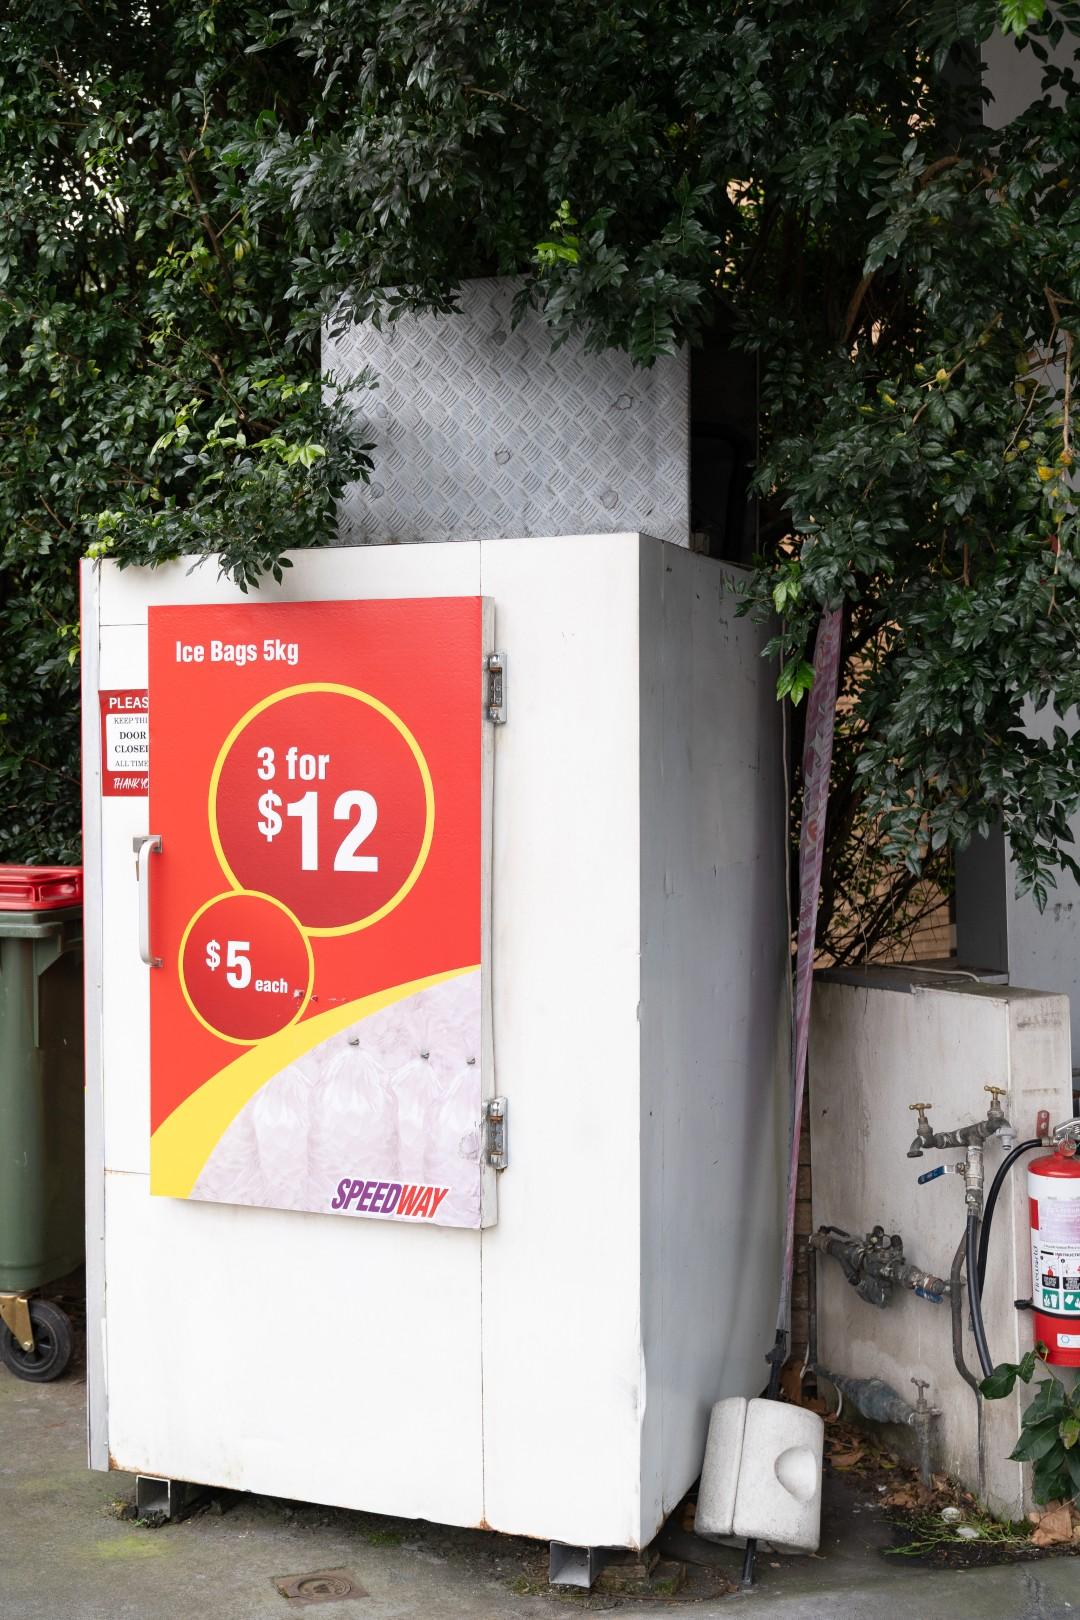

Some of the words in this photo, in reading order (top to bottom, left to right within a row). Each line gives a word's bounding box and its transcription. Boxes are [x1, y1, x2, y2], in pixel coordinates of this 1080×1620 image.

[175, 641, 205, 663] Ice
[211, 640, 258, 666] Bags
[263, 639, 299, 666] 5kg
[119, 731, 147, 740] DOOR
[257, 747, 276, 781] 3
[286, 746, 330, 780] for
[113, 778, 139, 790] THANK
[257, 789, 379, 873] $12
[205, 940, 252, 989] $5
[255, 978, 288, 994] each
[331, 1178, 449, 1218] SPEEDWAY
